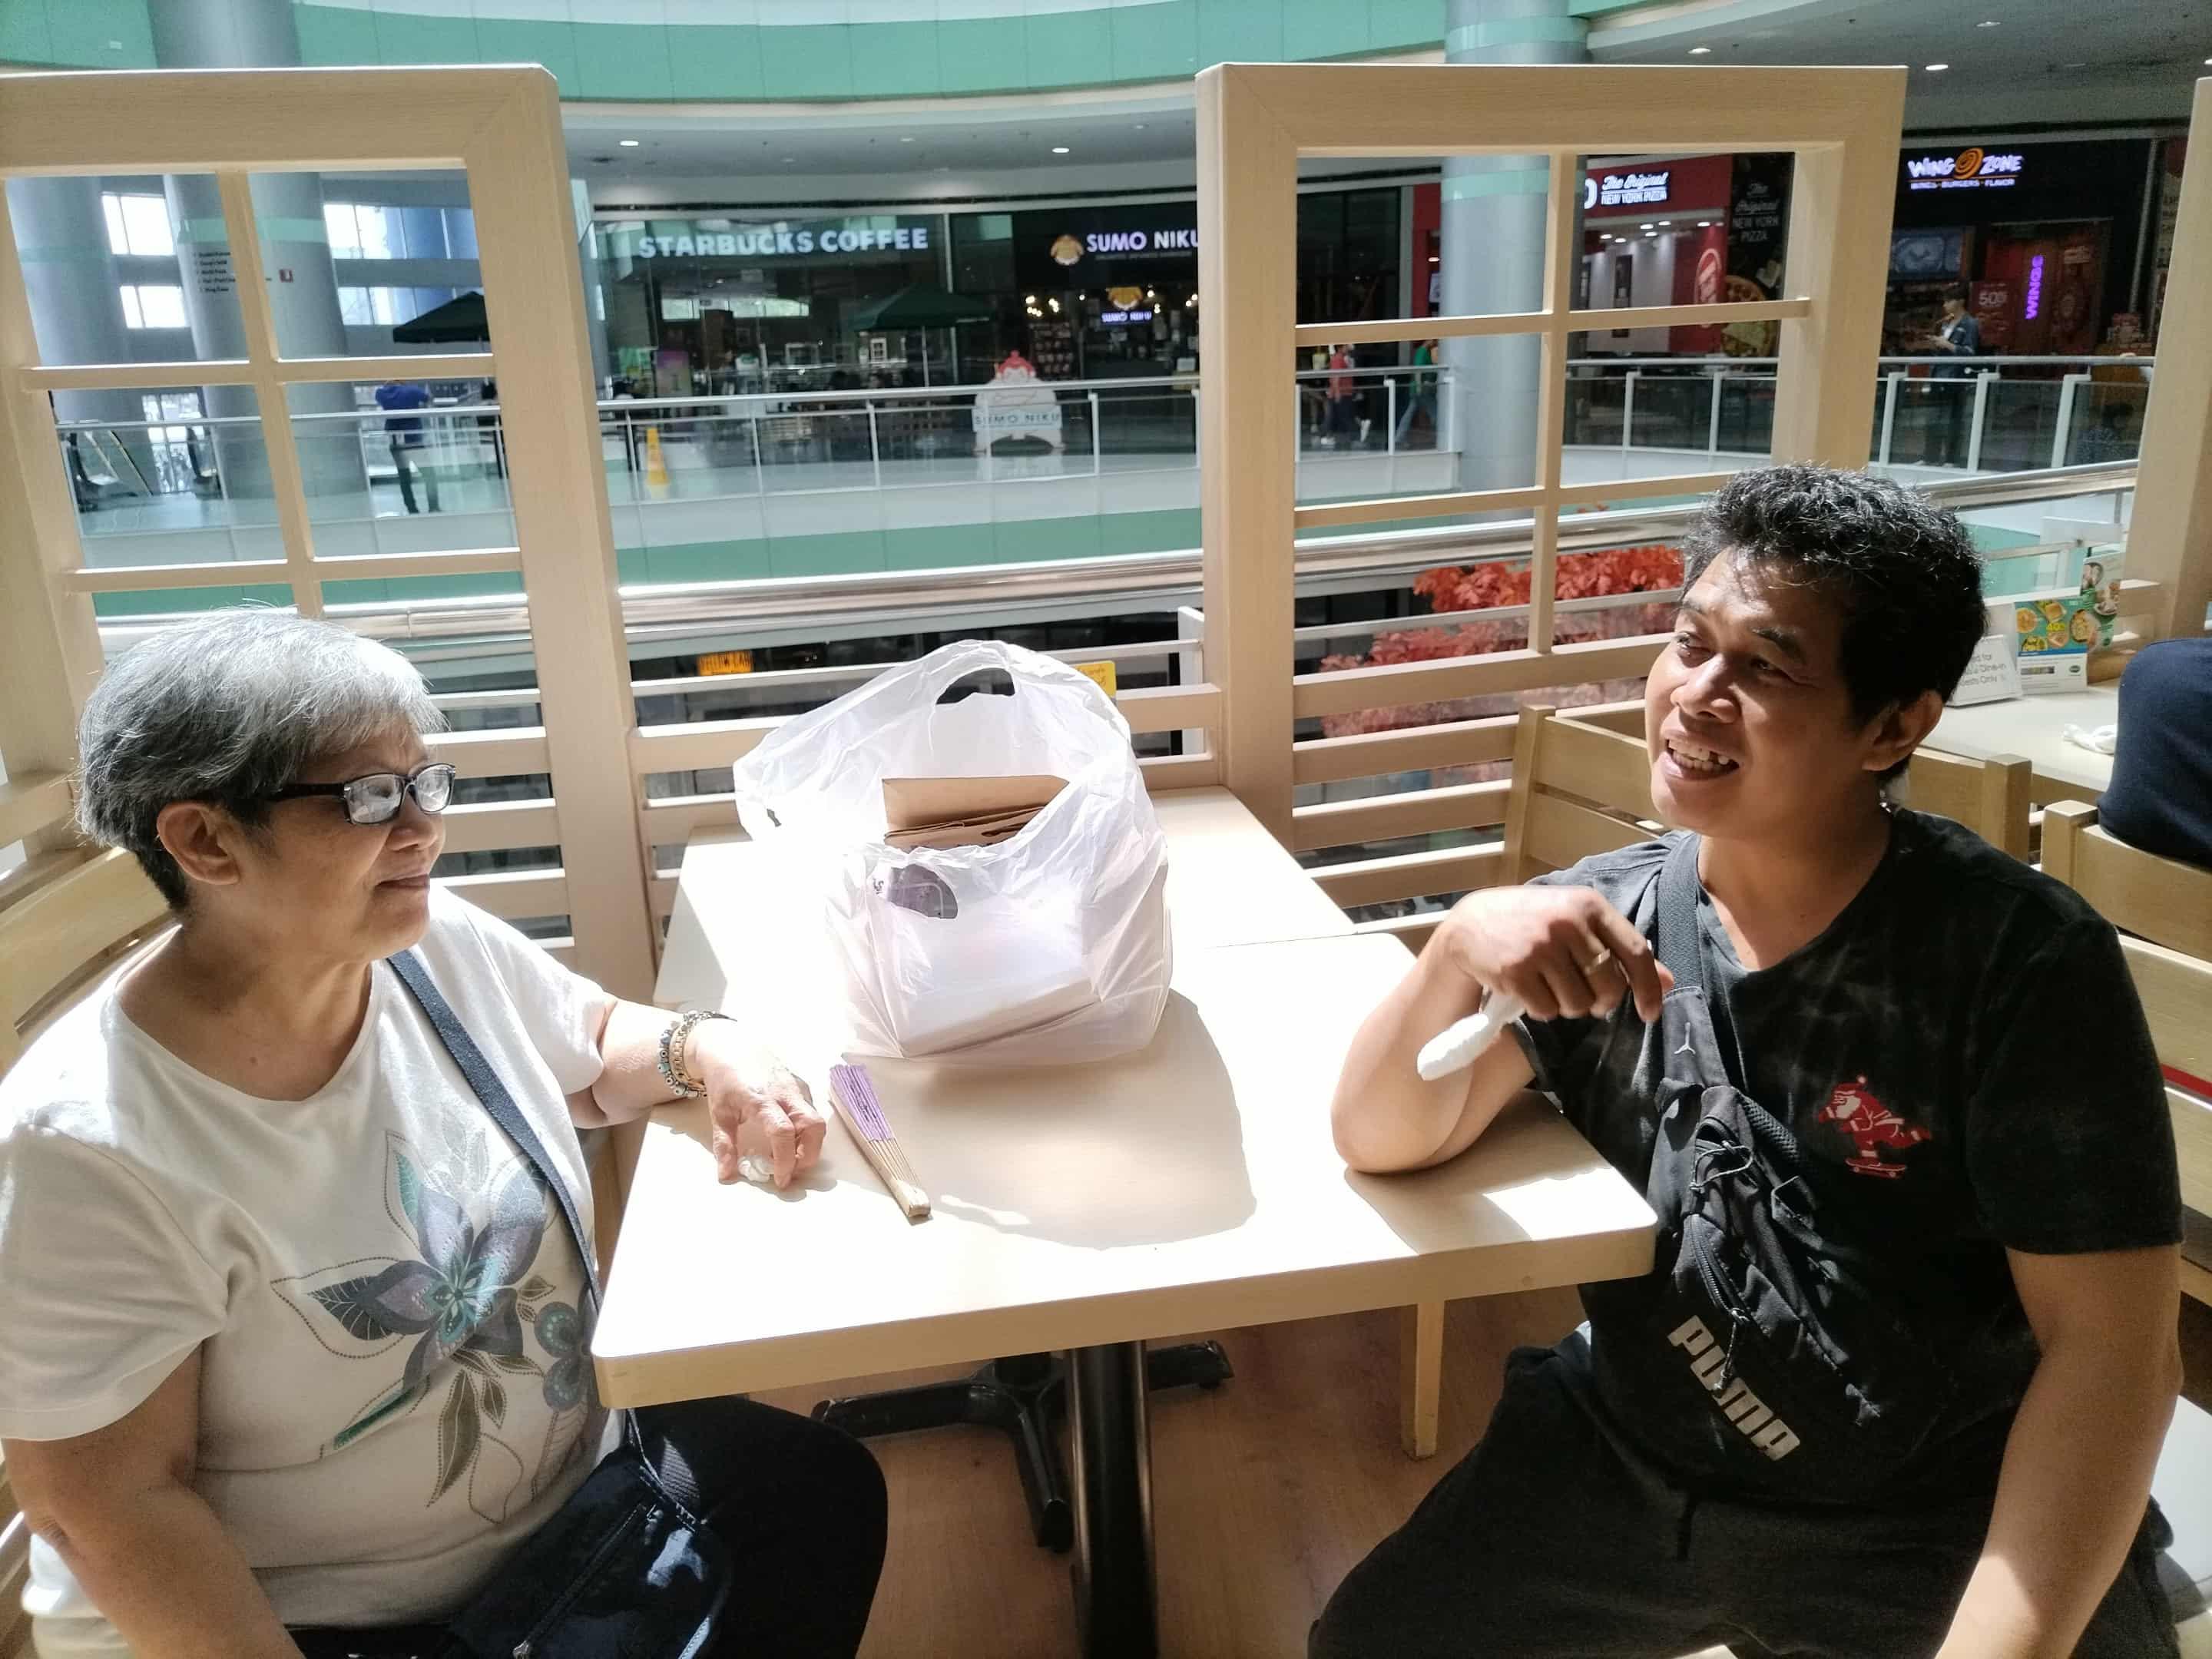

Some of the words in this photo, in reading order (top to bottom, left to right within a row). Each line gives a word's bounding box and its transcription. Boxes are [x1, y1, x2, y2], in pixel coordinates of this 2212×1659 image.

[1908, 157, 1955, 177] WING
[1979, 155, 2024, 174] ZONE
[1601, 175, 1624, 190] The
[1624, 171, 1669, 190] Original
[1941, 179, 1980, 188] BURGERS
[1984, 178, 2015, 187] FLAVOR
[1601, 193, 1621, 205] NEW
[1621, 191, 1643, 204] YORK
[1643, 190, 1667, 203] PIZZA
[1755, 216, 1779, 227] YORK
[638, 231, 815, 259] STARBUCKS
[820, 228, 929, 252] COFFEE
[1086, 231, 1147, 253] SUMO
[1740, 230, 1768, 243] PIZZA
[2025, 254, 2045, 320] WINGS
[1667, 1314, 1801, 1462] PUMA
